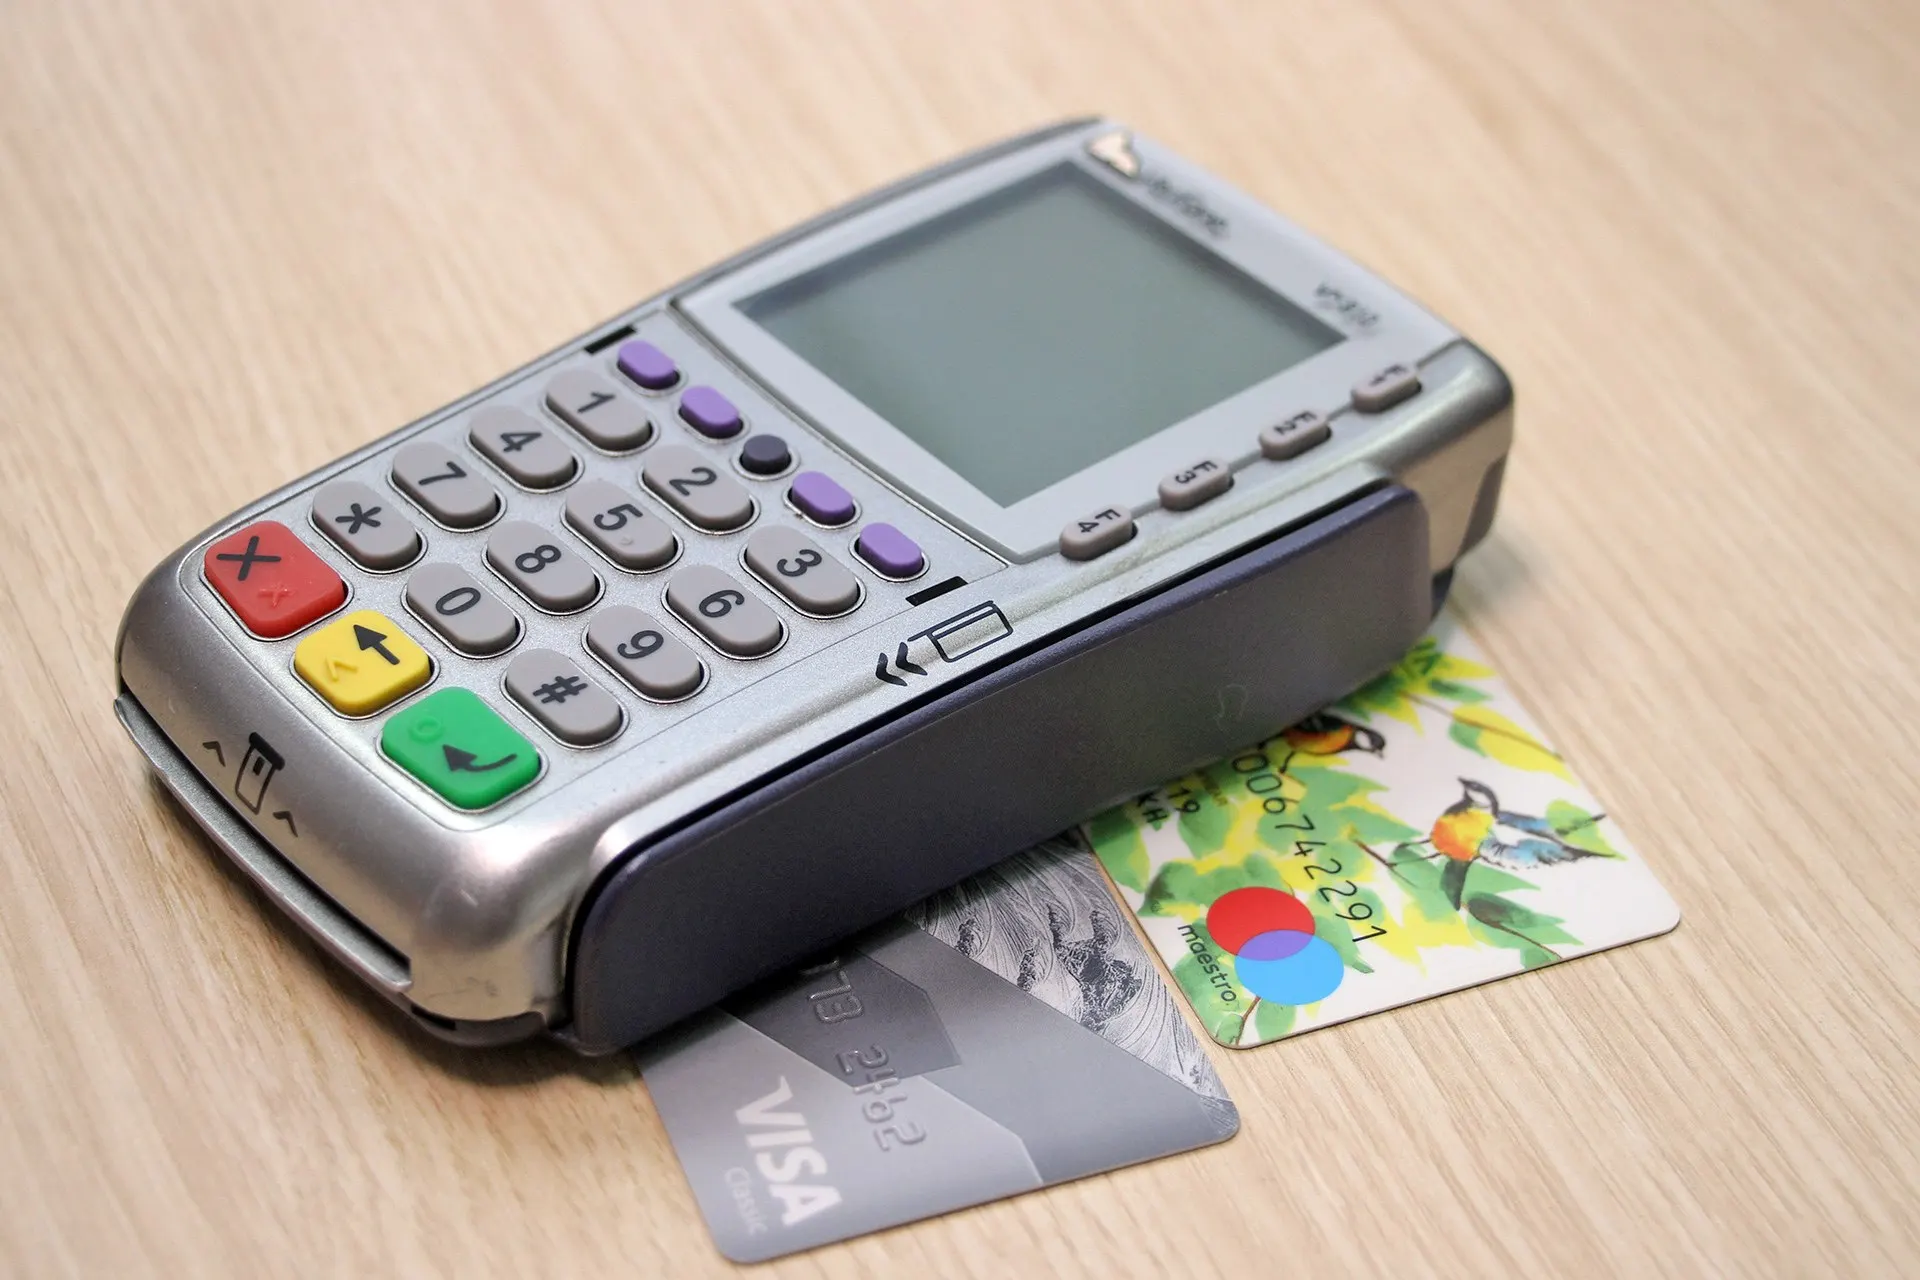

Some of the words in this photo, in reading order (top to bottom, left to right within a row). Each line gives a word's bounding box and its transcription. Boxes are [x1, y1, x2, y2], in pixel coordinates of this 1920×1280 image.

[1274, 410, 1317, 436] F2
[577, 391, 616, 414] 1
[669, 466, 717, 497] 2
[776, 548, 823, 578] 3
[1174, 460, 1218, 485] F3
[500, 430, 543, 453] 4
[593, 503, 643, 531] 5
[699, 589, 745, 617] 6
[1077, 508, 1121, 533] F4
[419, 461, 466, 486] 7
[515, 544, 562, 573] 8
[617, 630, 664, 660] 9
[436, 586, 481, 616] 0
[1177, 924, 1236, 1003] maestro
[735, 1075, 843, 1226] VISA
